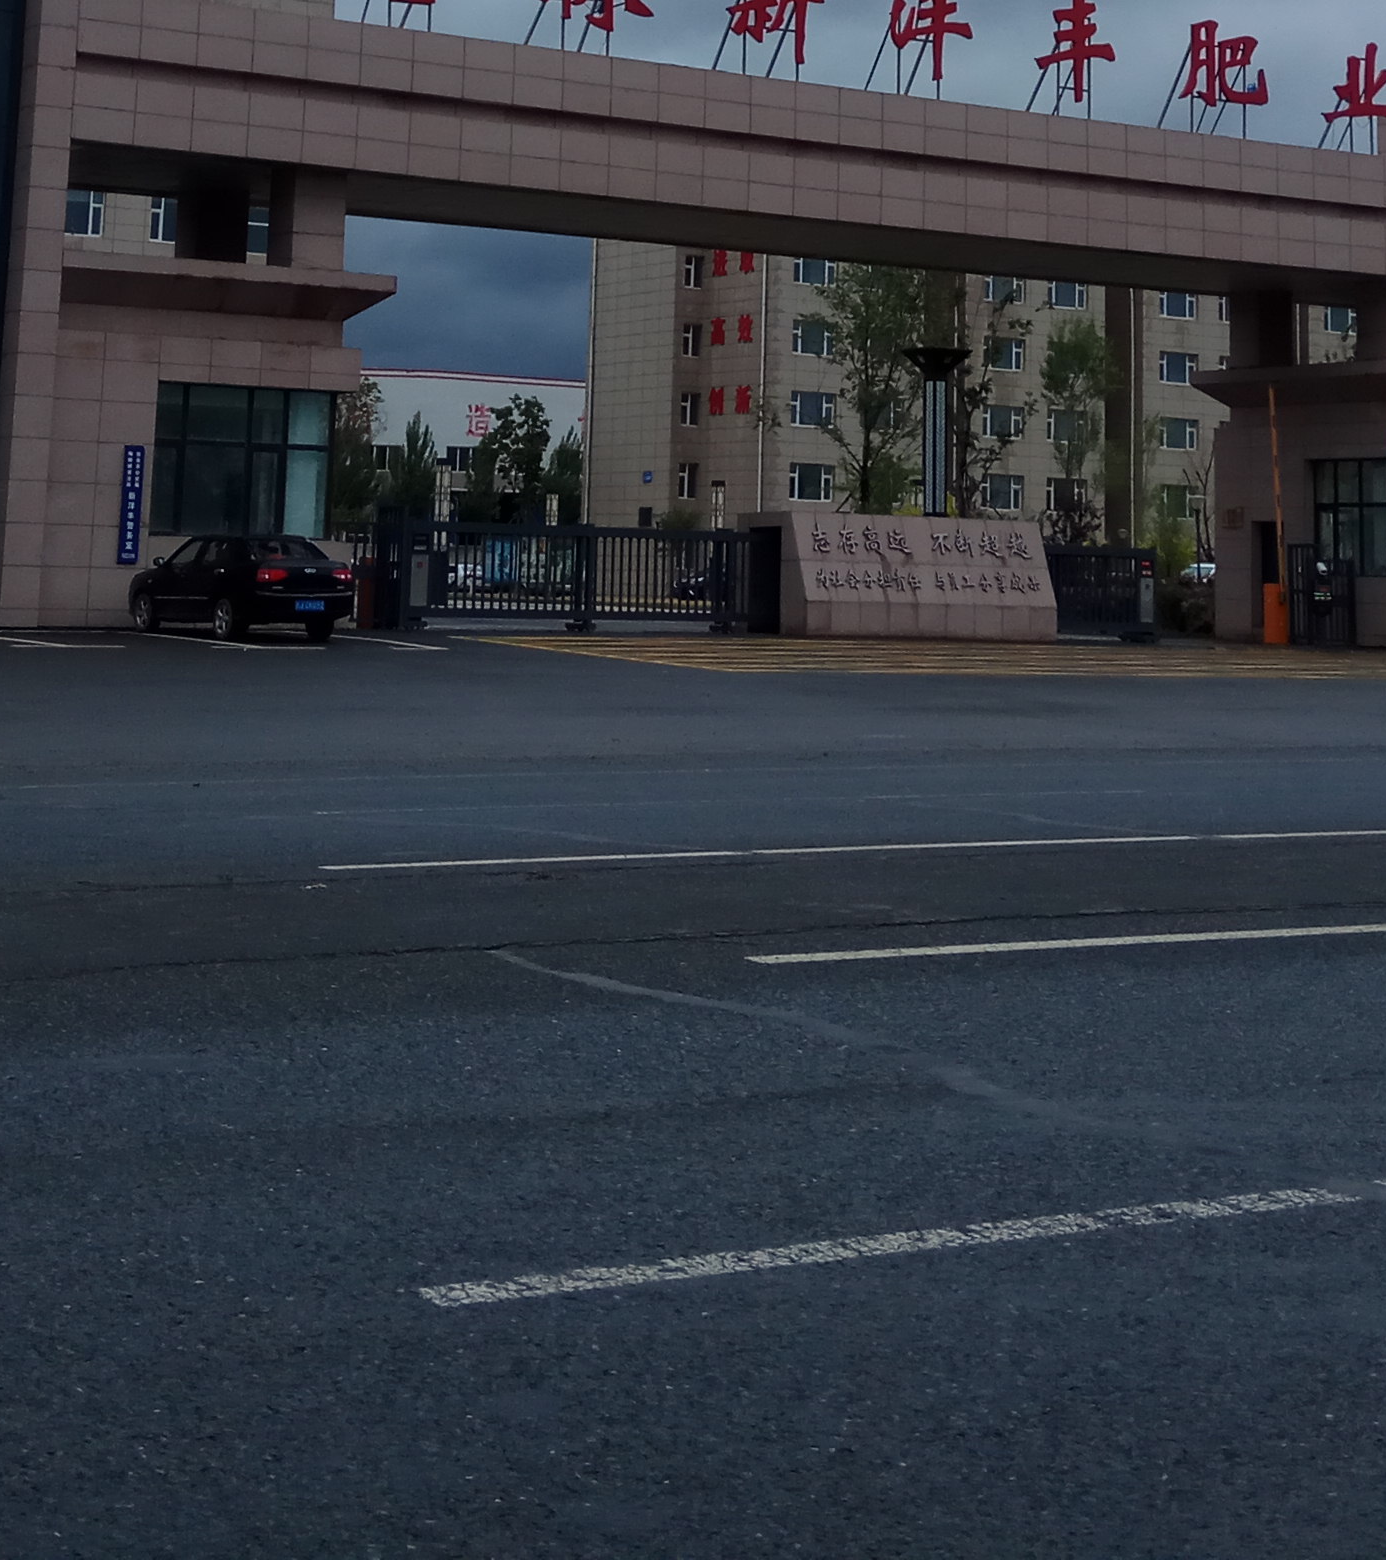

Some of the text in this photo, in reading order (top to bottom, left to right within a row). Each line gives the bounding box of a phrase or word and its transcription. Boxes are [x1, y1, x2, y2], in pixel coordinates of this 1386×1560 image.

[812, 523, 1033, 560] 志存高远 不断超越
